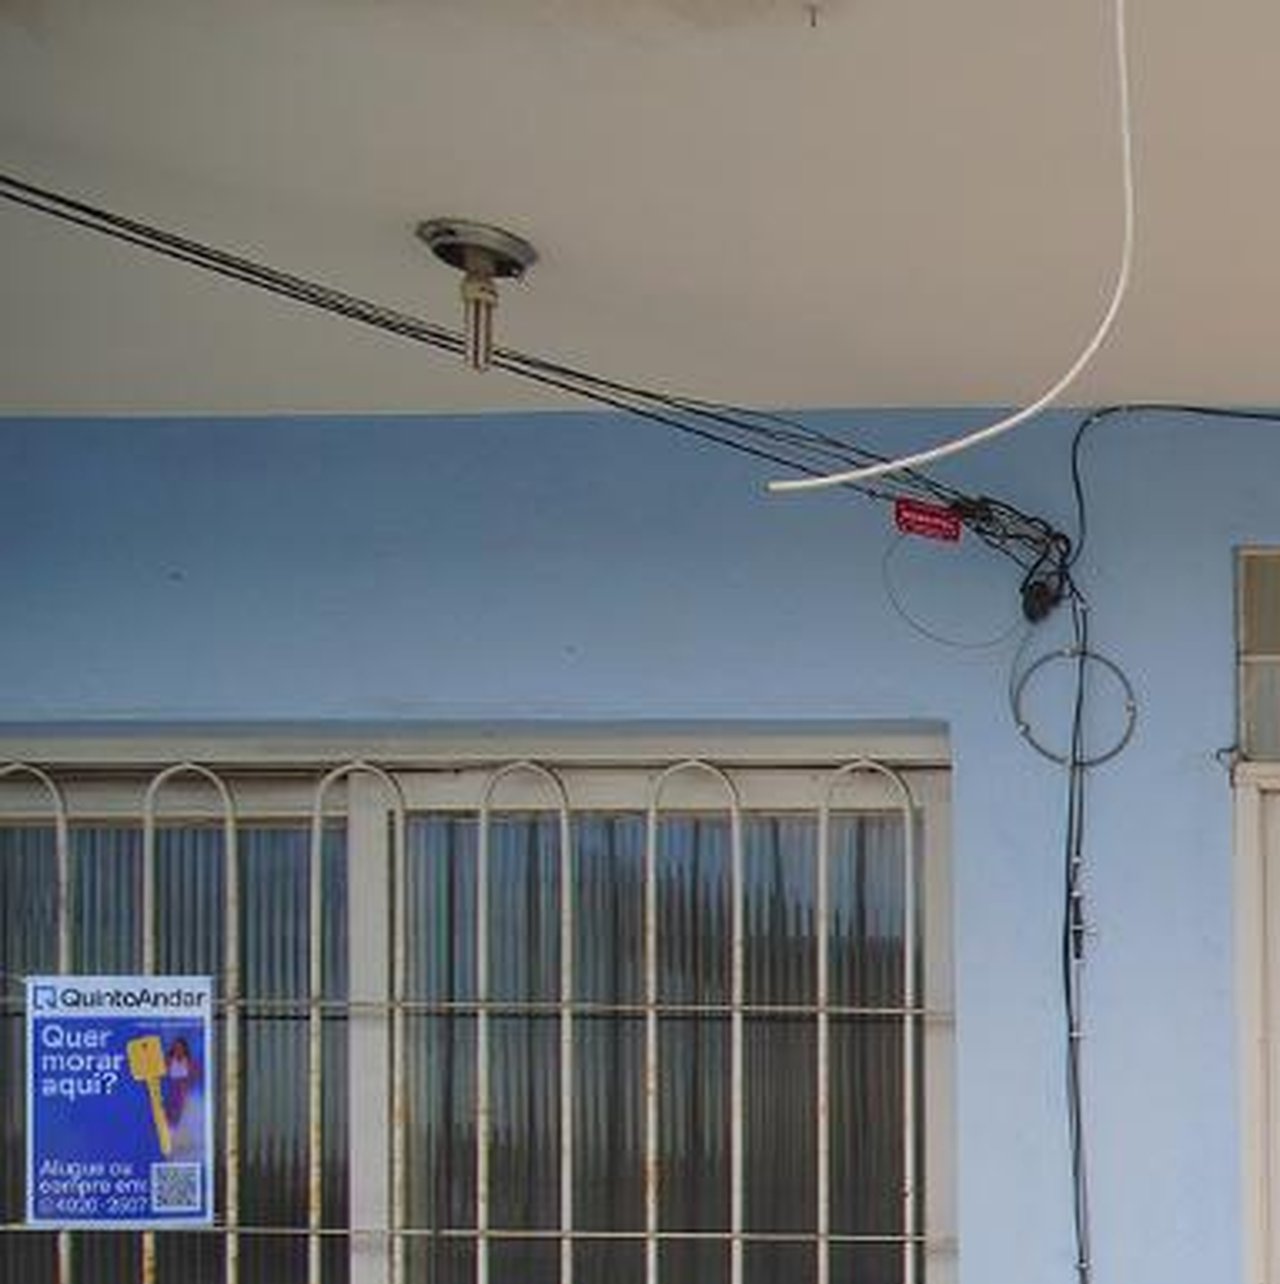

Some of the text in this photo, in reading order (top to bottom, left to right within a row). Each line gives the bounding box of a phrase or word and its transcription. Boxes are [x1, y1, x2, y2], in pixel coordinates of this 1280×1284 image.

[61, 987, 206, 1008] QuintoAndar
[42, 1025, 112, 1051] Quer
[42, 1054, 124, 1073] morar
[42, 1073, 118, 1101] aqui?
